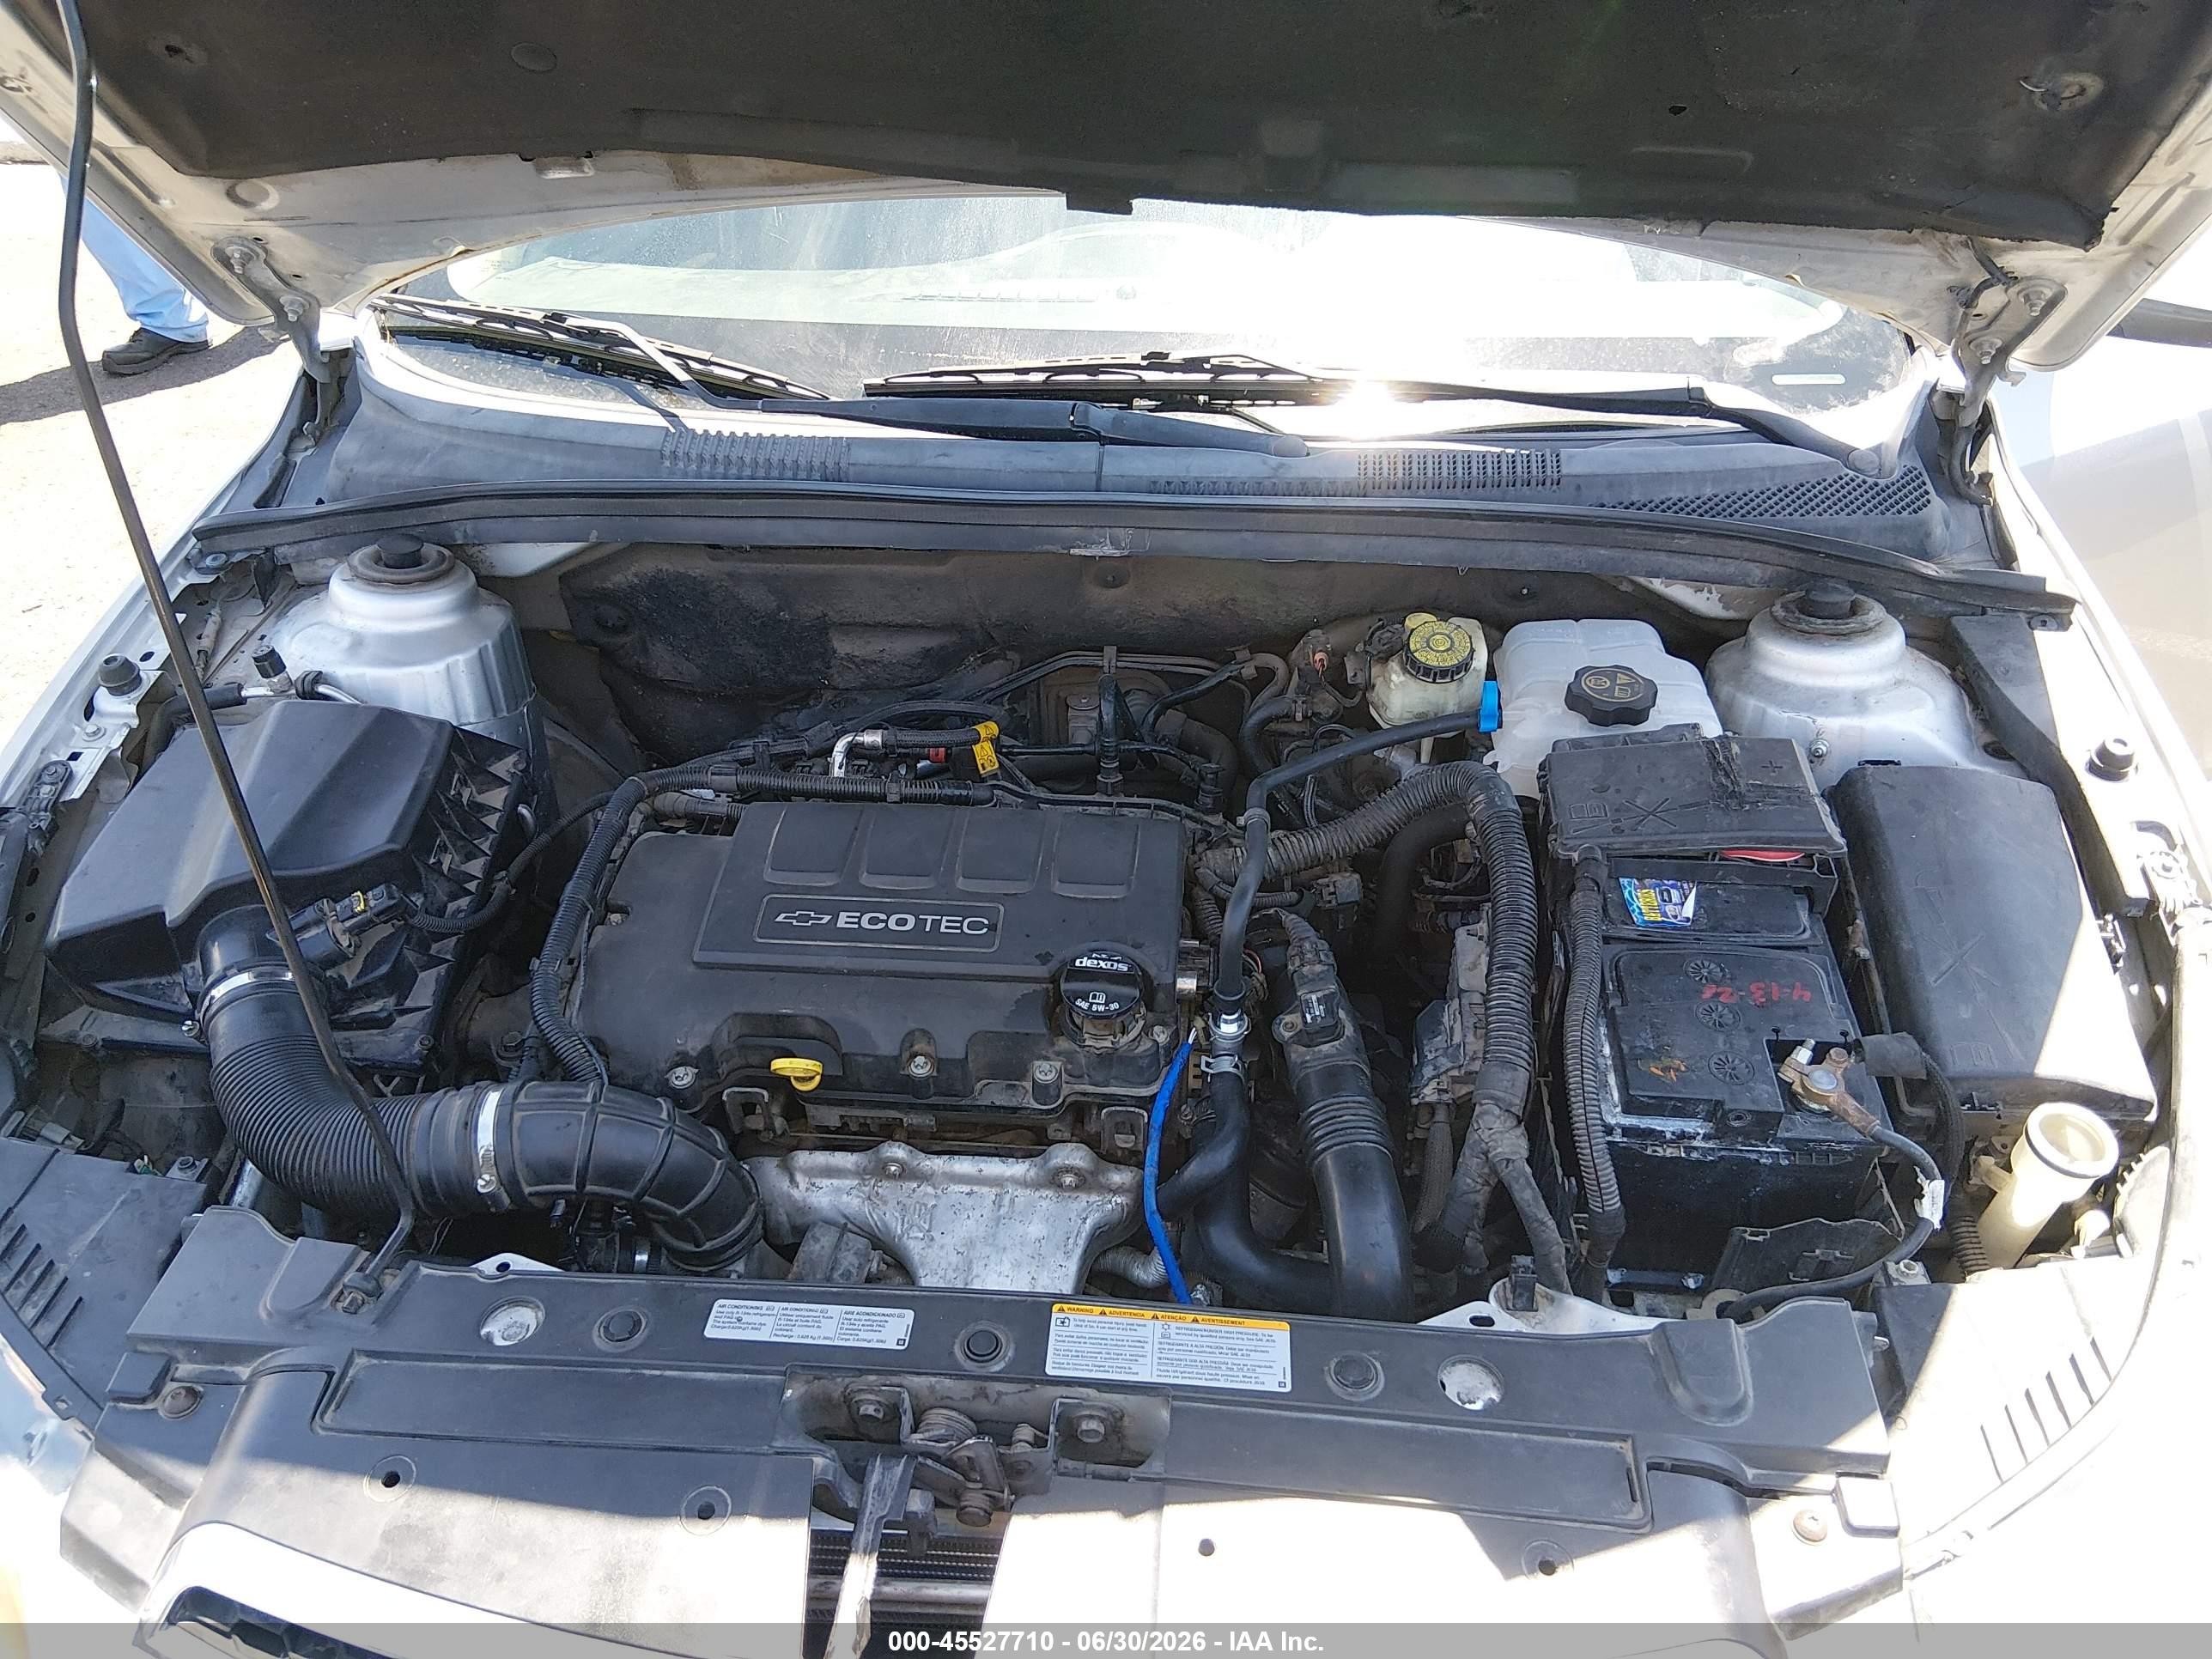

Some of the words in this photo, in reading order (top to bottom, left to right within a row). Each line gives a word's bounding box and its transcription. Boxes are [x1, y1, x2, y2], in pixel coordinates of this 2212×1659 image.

[836, 911, 989, 935] ECOTEC
[1075, 956, 1129, 972] dexos
[1075, 999, 1090, 1010] SAE
[1091, 1001, 1120, 1012] 5W-30
